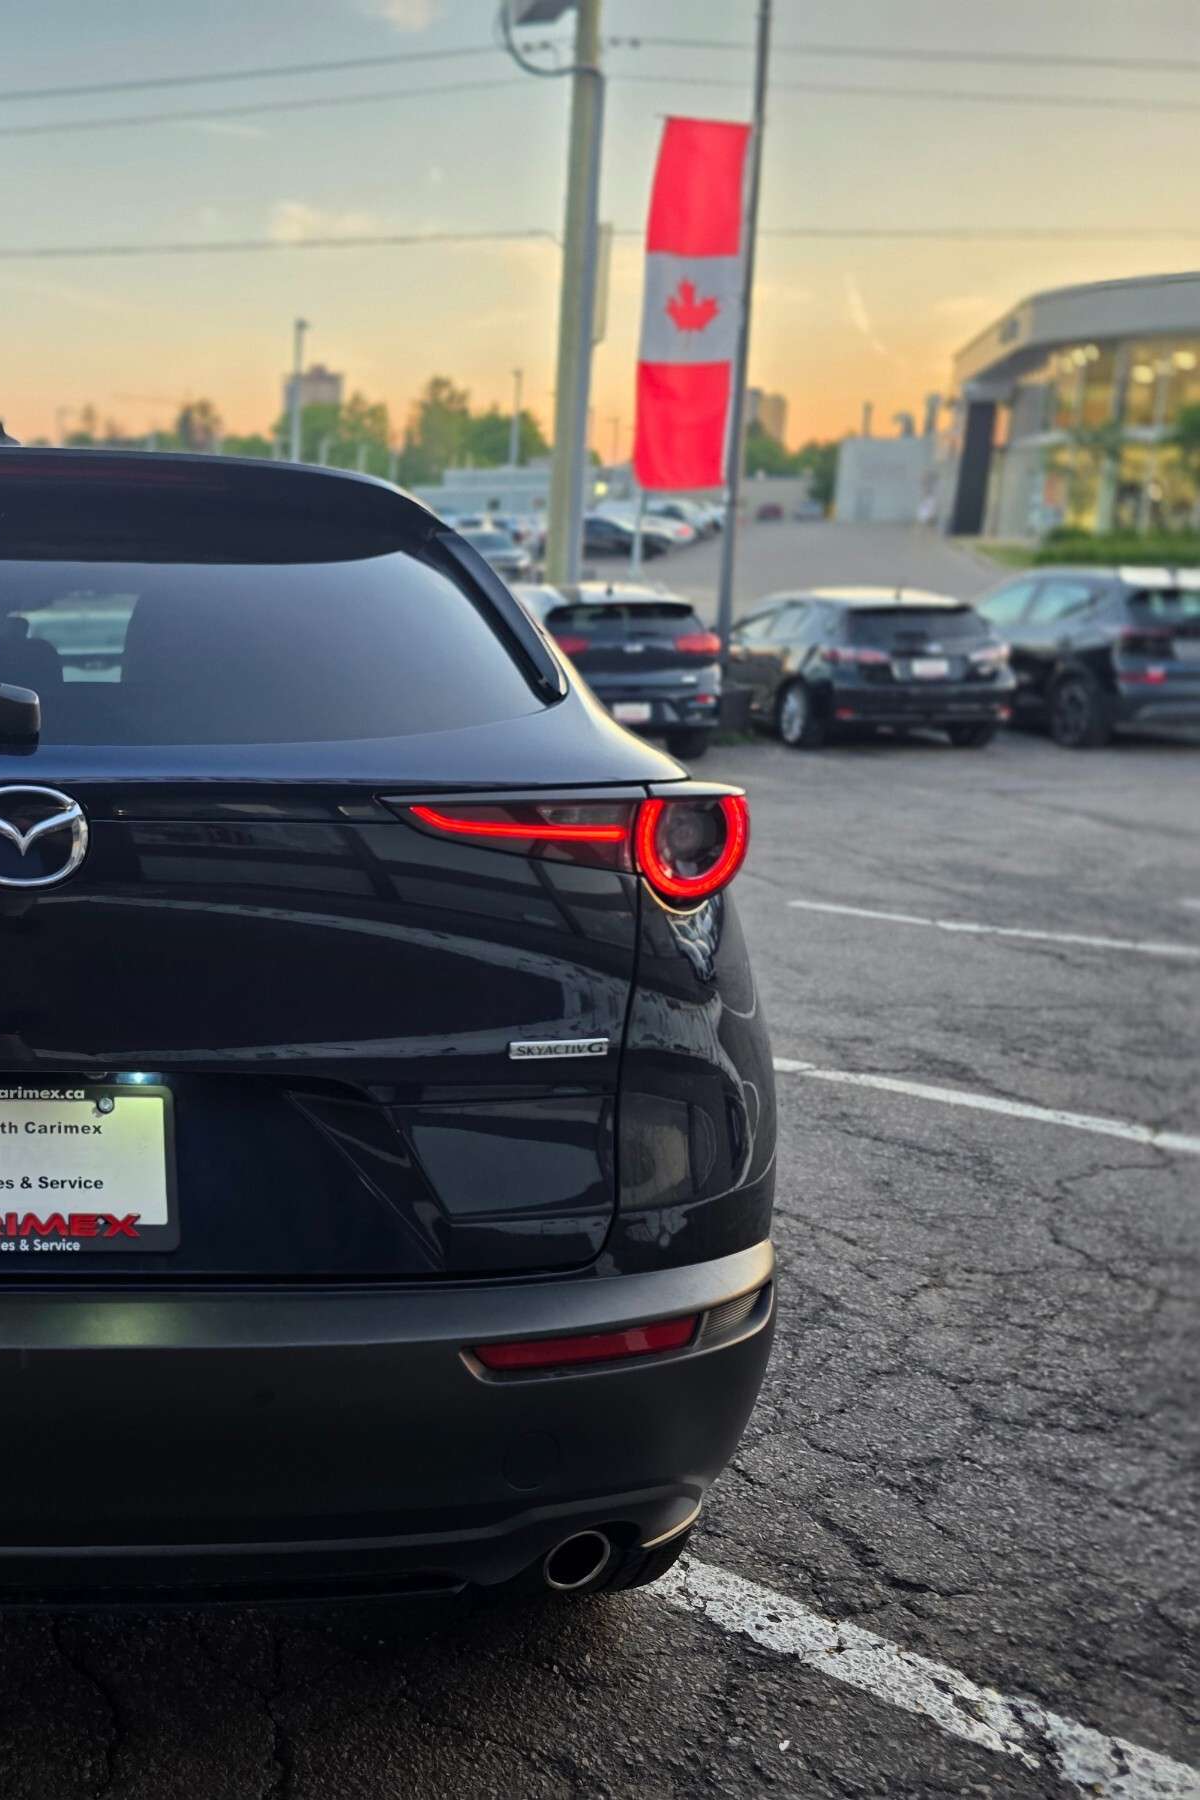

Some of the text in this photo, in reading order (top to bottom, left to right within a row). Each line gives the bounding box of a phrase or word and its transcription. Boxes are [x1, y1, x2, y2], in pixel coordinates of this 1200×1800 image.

[24, 1121, 103, 1136] Carimex
[19, 1177, 33, 1190] &
[38, 1176, 104, 1190] Service
[19, 1239, 30, 1252] &
[33, 1238, 81, 1252] Service
